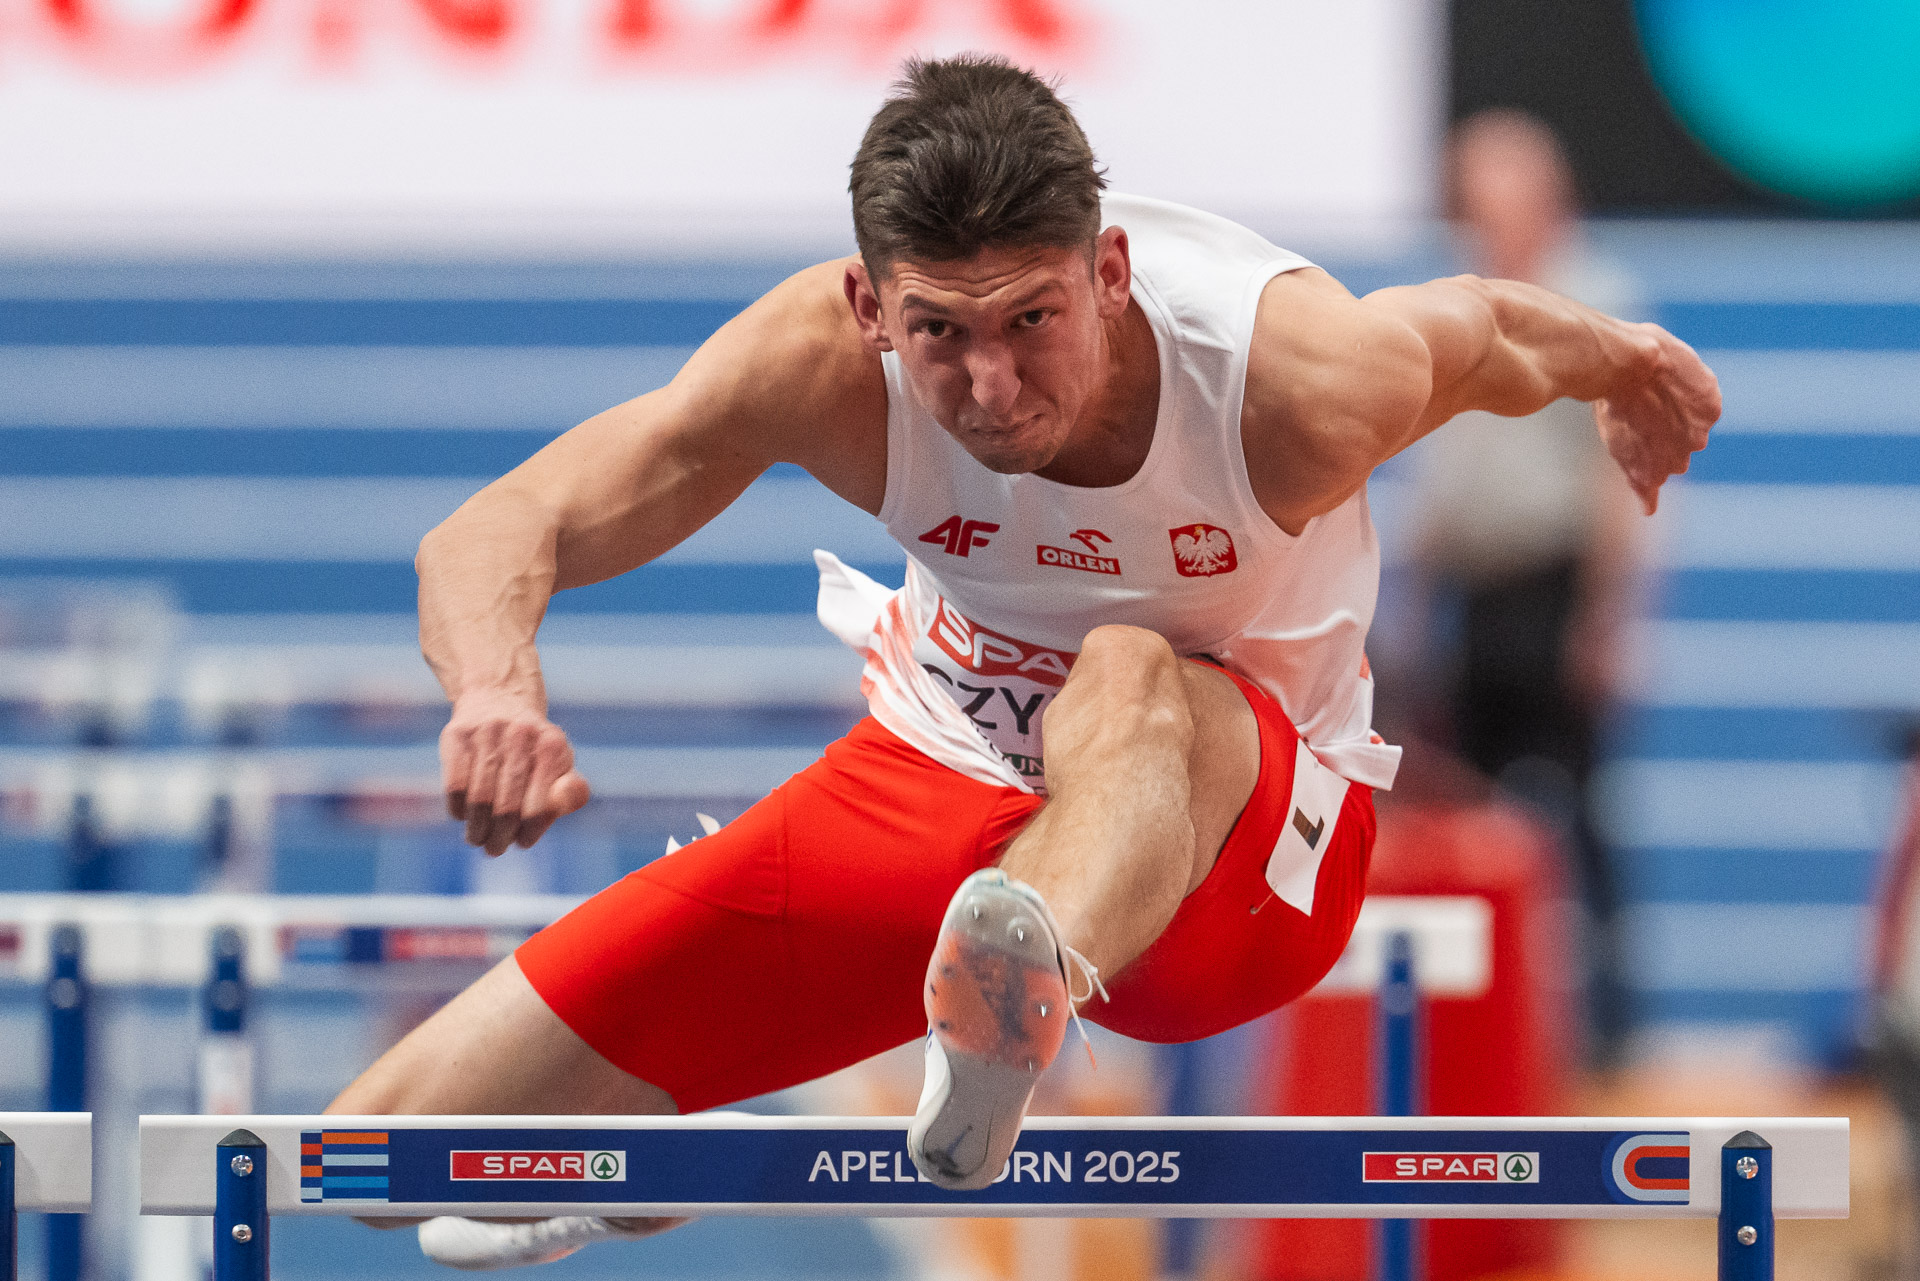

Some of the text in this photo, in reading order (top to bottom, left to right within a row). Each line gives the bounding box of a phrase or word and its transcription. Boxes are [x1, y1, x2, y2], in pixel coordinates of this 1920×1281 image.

[918, 515, 1000, 558] 4F
[1041, 548, 1115, 573] ORLEN
[938, 599, 1070, 677] SPA
[921, 663, 1058, 736] ZY
[483, 1156, 582, 1174] SPAR
[808, 1150, 1181, 1183] APELRN 2025
[1395, 1158, 1496, 1176] SPAR
